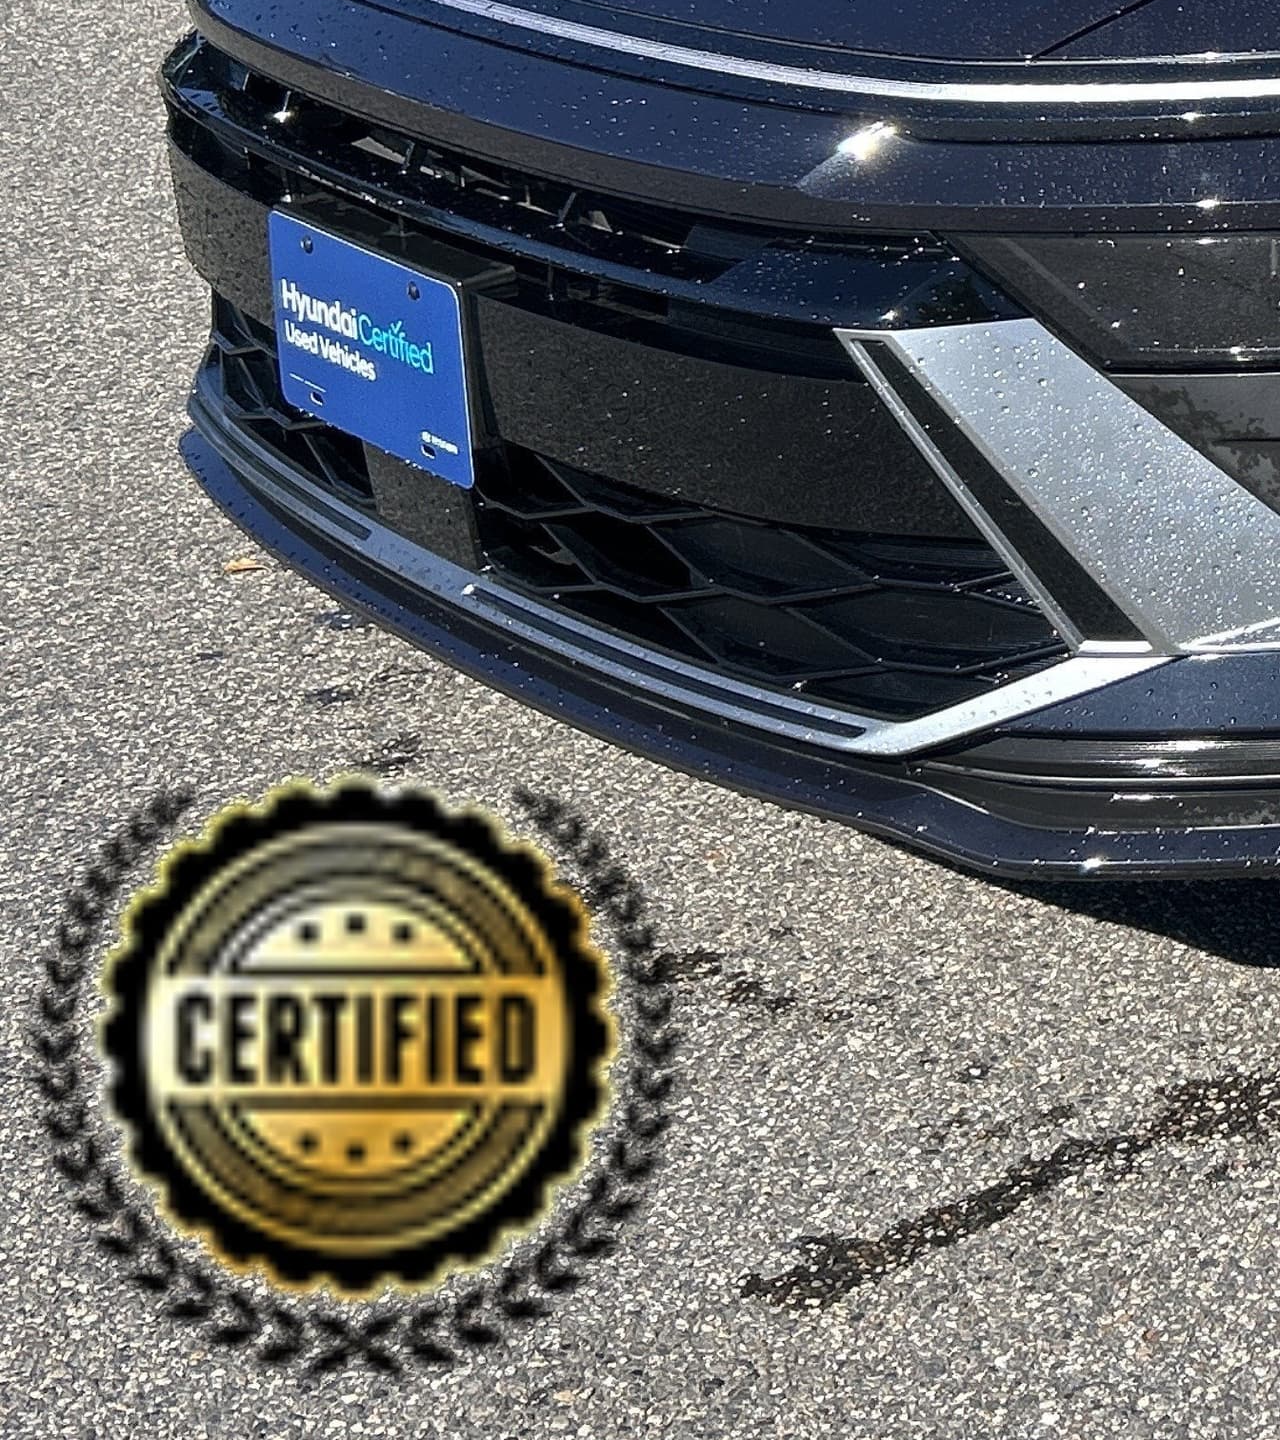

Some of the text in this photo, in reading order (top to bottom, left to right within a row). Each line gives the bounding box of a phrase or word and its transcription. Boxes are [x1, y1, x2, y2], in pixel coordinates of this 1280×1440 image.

[281, 278, 434, 375] Hyundai Certified
[284, 319, 378, 382] Used Vehicles
